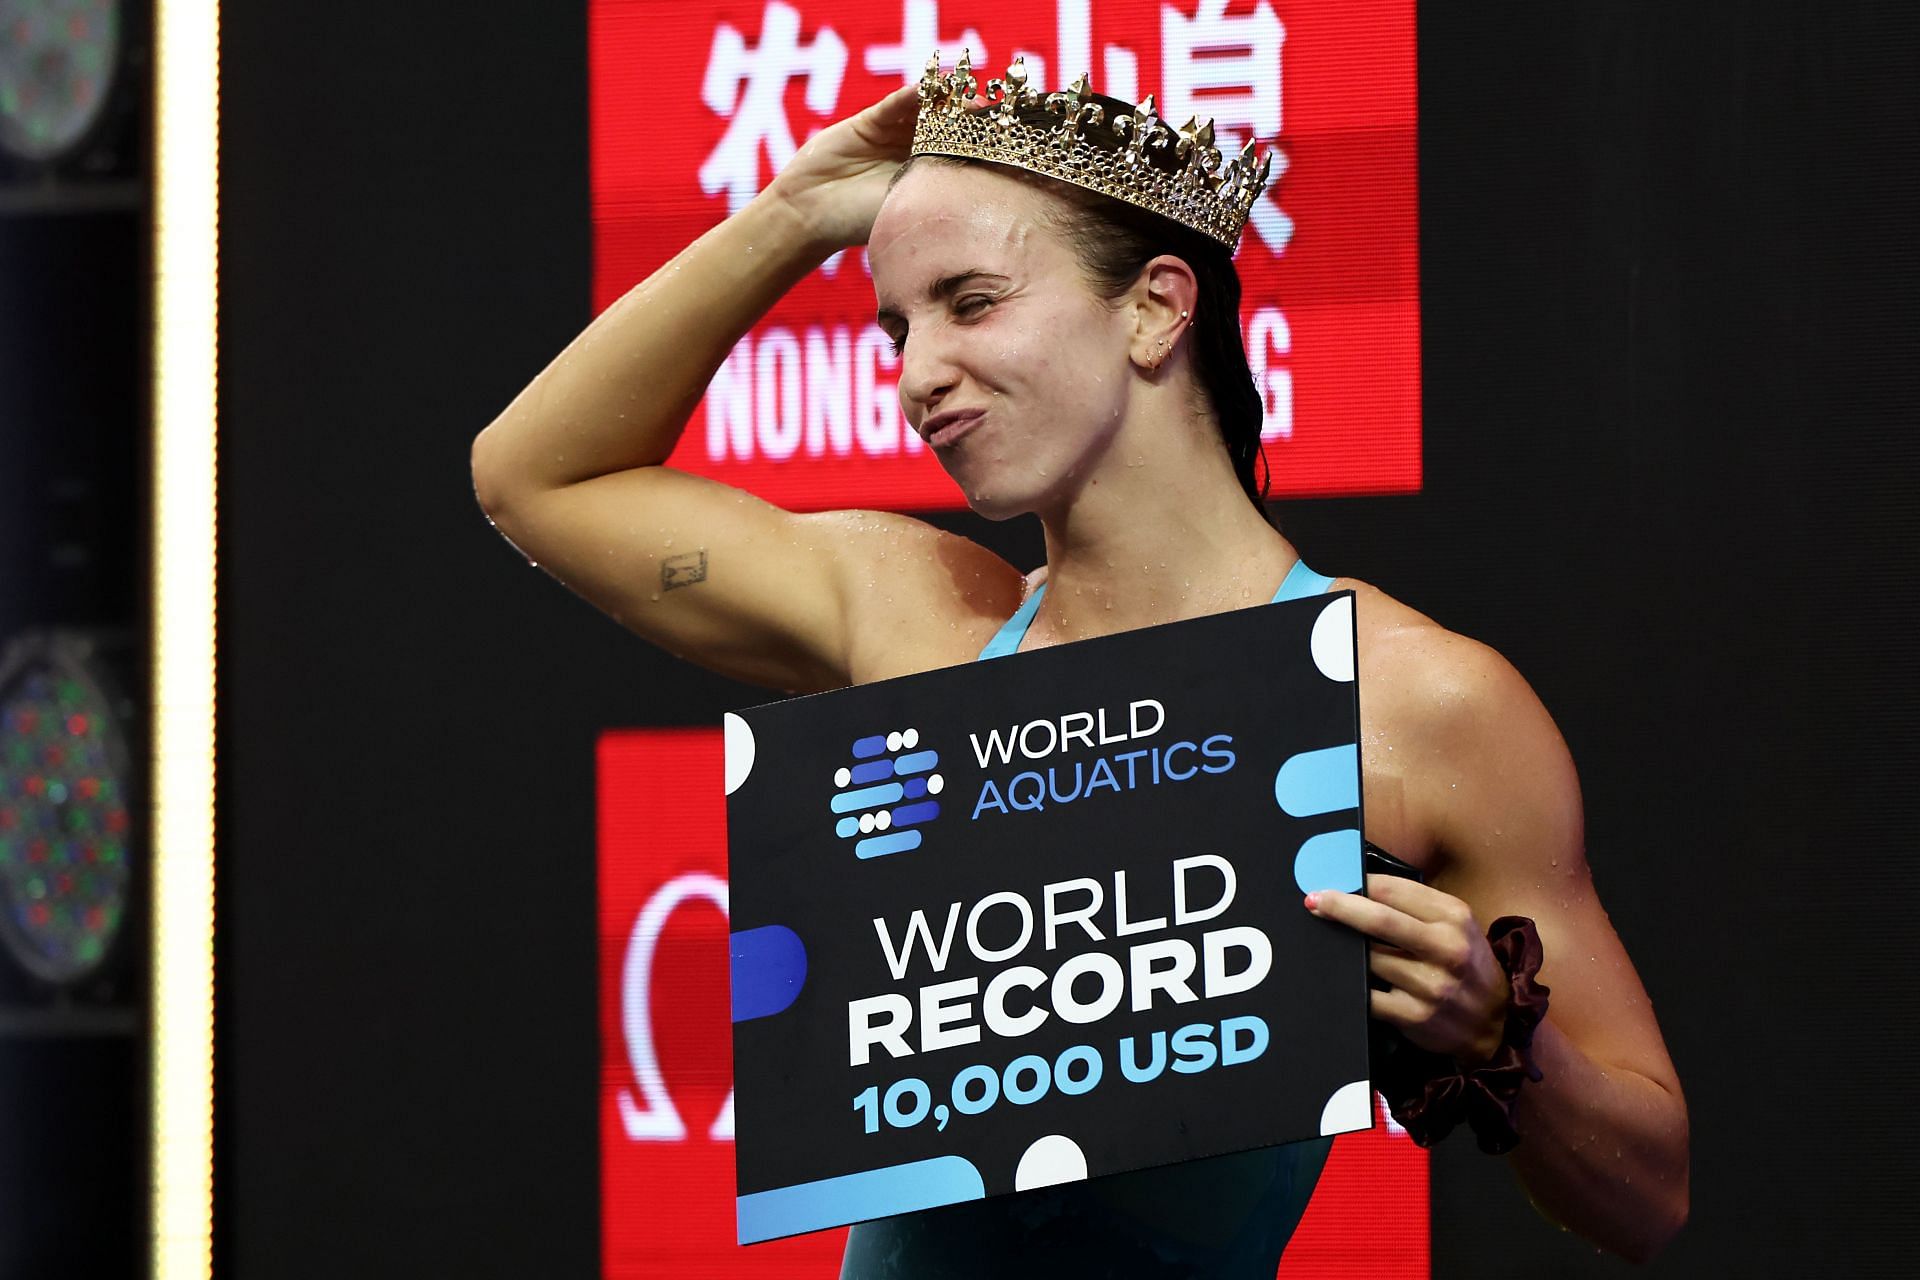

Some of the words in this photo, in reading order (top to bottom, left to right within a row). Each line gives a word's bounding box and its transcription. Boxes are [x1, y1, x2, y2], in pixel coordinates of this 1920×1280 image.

[706, 322, 923, 464] NONG
[969, 699, 1165, 769] WORLD
[971, 734, 1237, 821] AQUATICS
[872, 854, 1237, 981] WORLD
[848, 926, 1273, 1067] RECORD
[853, 1045, 1104, 1134] 10,000
[1119, 1015, 1270, 1083] USD
